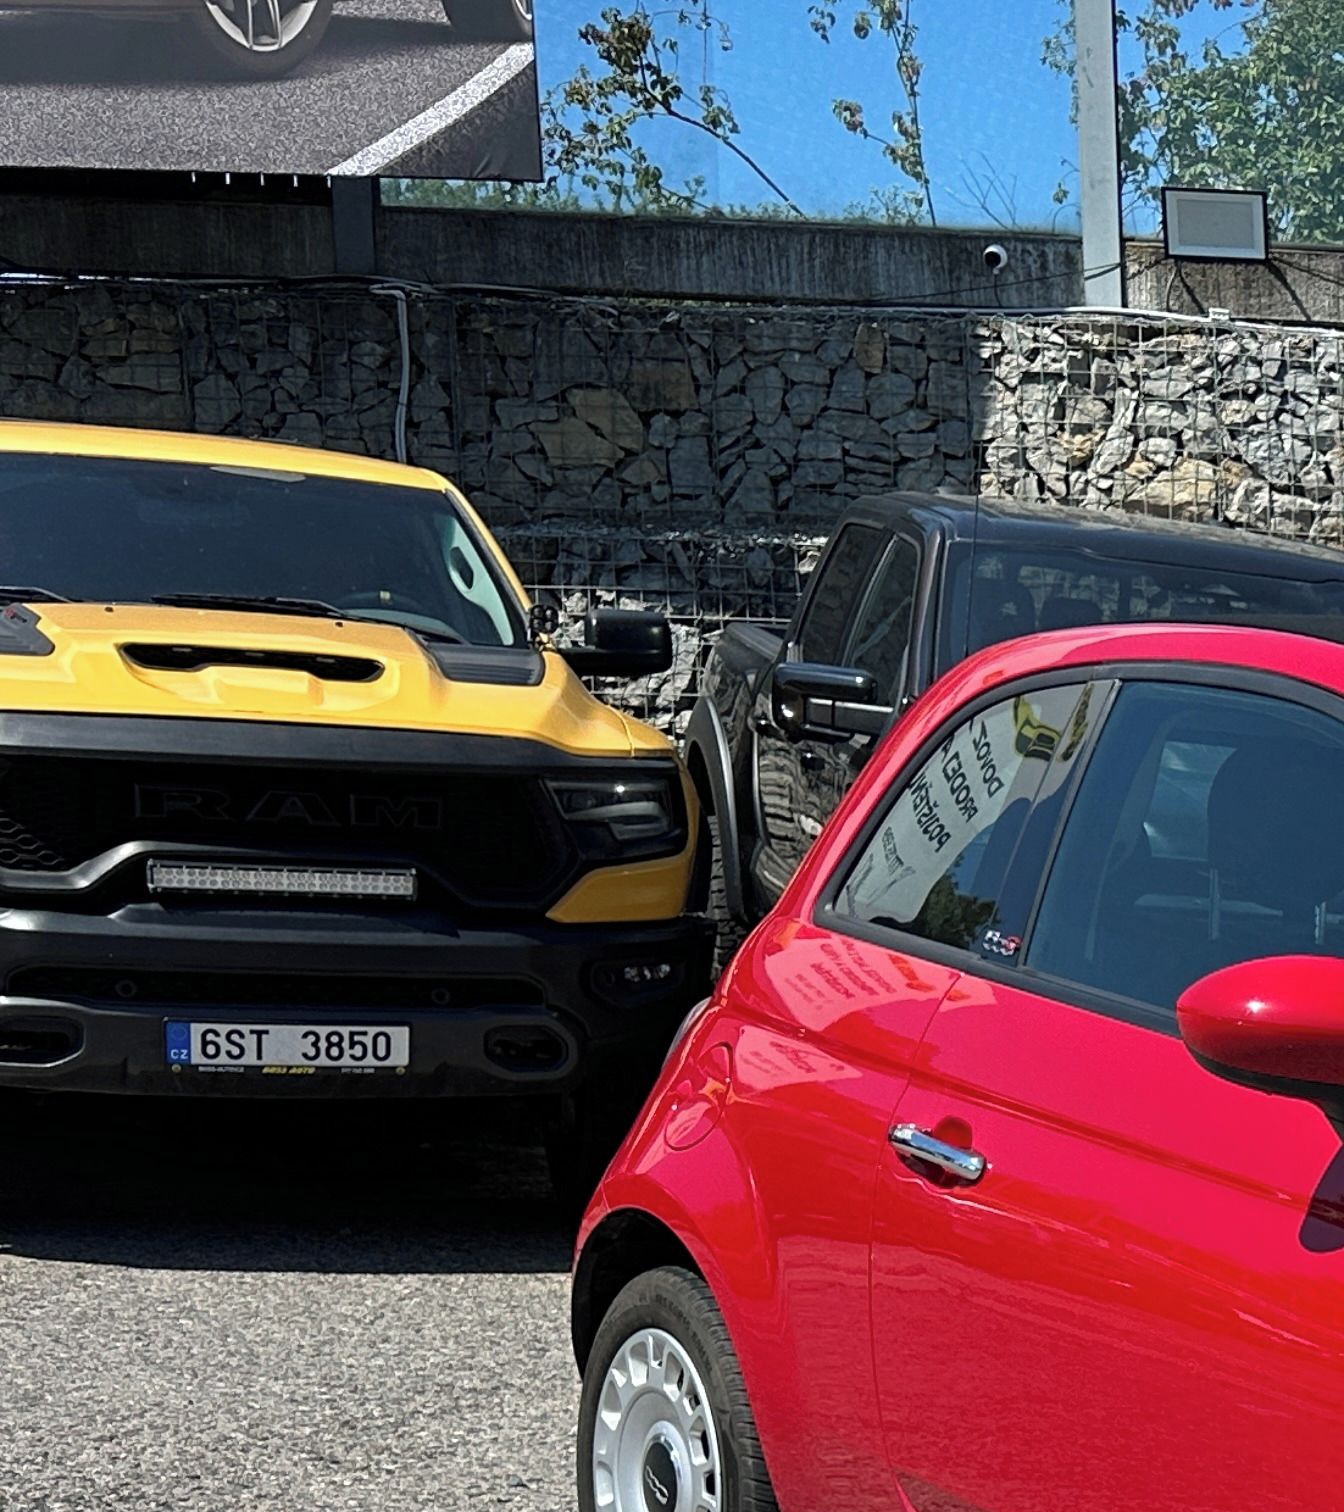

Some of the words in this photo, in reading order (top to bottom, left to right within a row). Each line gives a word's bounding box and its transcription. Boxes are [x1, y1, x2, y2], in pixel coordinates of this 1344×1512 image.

[135, 784, 442, 829] RAM
[170, 1049, 188, 1059] CZ
[200, 1028, 270, 1060] 6ST
[301, 1030, 392, 1061] 3850
